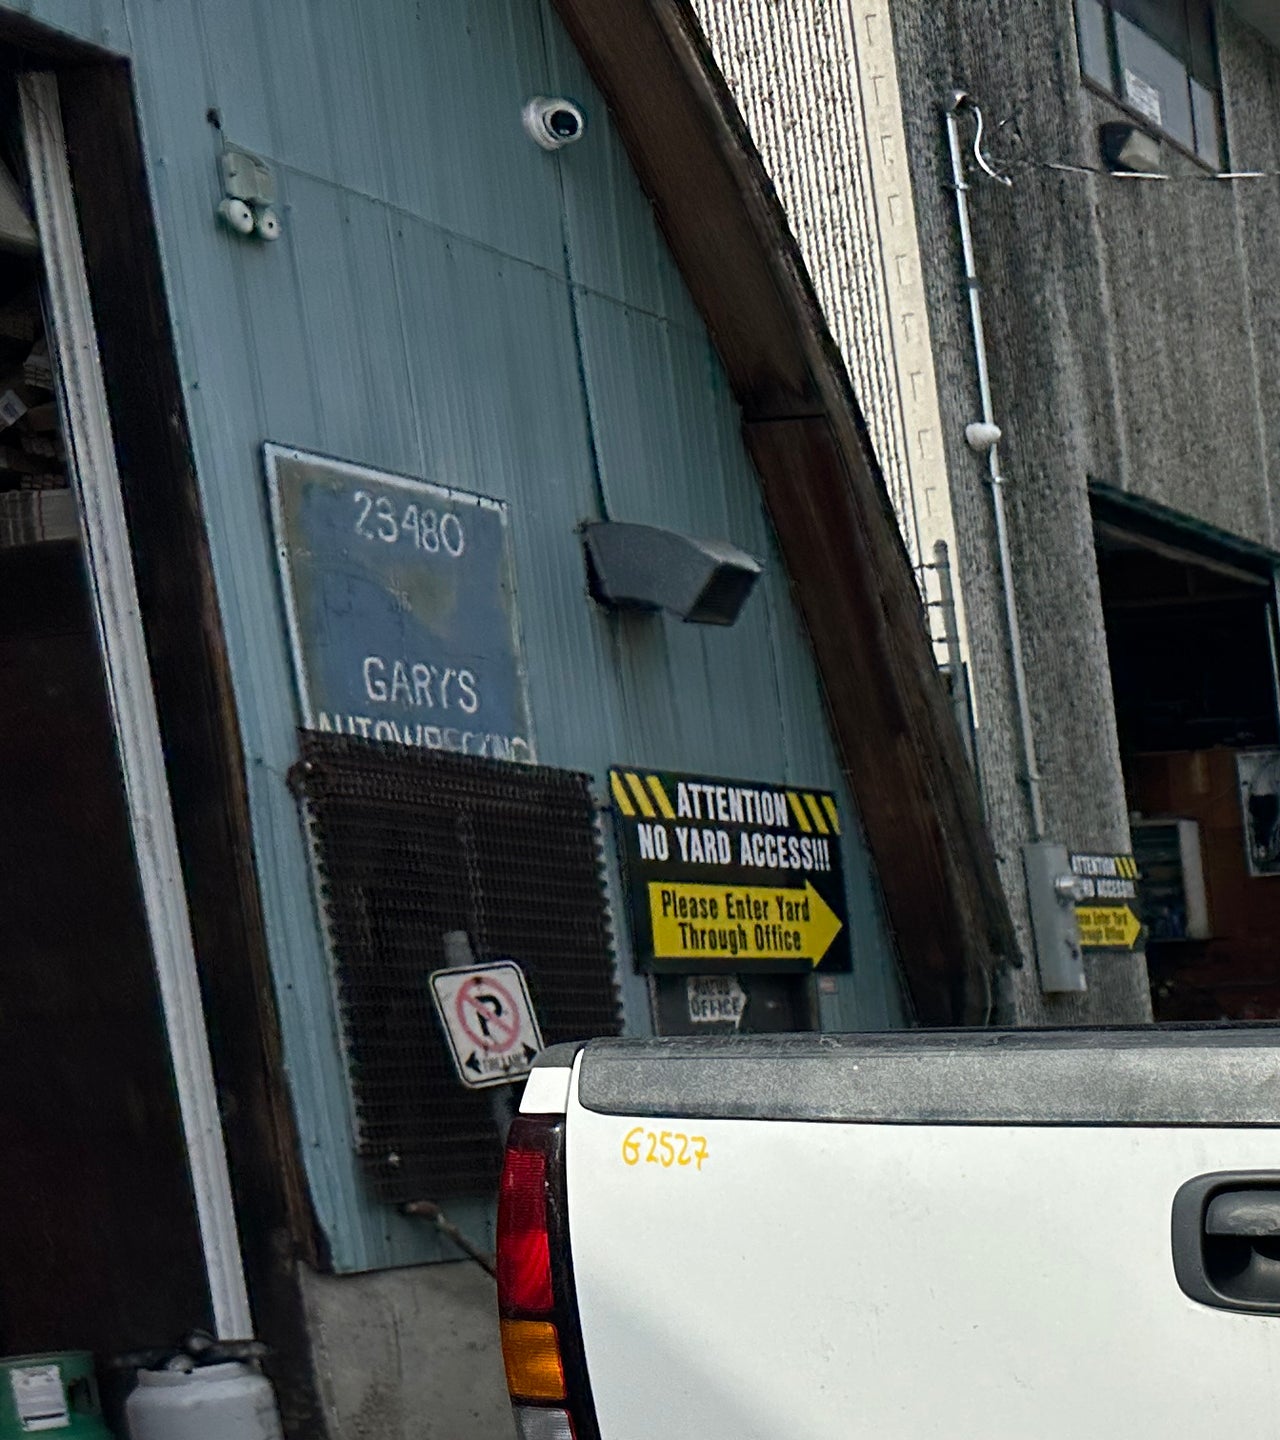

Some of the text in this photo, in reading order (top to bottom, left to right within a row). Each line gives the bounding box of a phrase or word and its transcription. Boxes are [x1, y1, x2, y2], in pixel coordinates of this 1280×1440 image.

[354, 491, 464, 557] 23480
[677, 782, 789, 828] ATTENTION
[638, 823, 831, 872] NO YARD ACCESS!!!
[1071, 855, 1116, 876] ATTENTION
[661, 890, 810, 922] Please Enter Yard
[678, 922, 802, 955] Through Office
[622, 1127, 709, 1170] G2527
